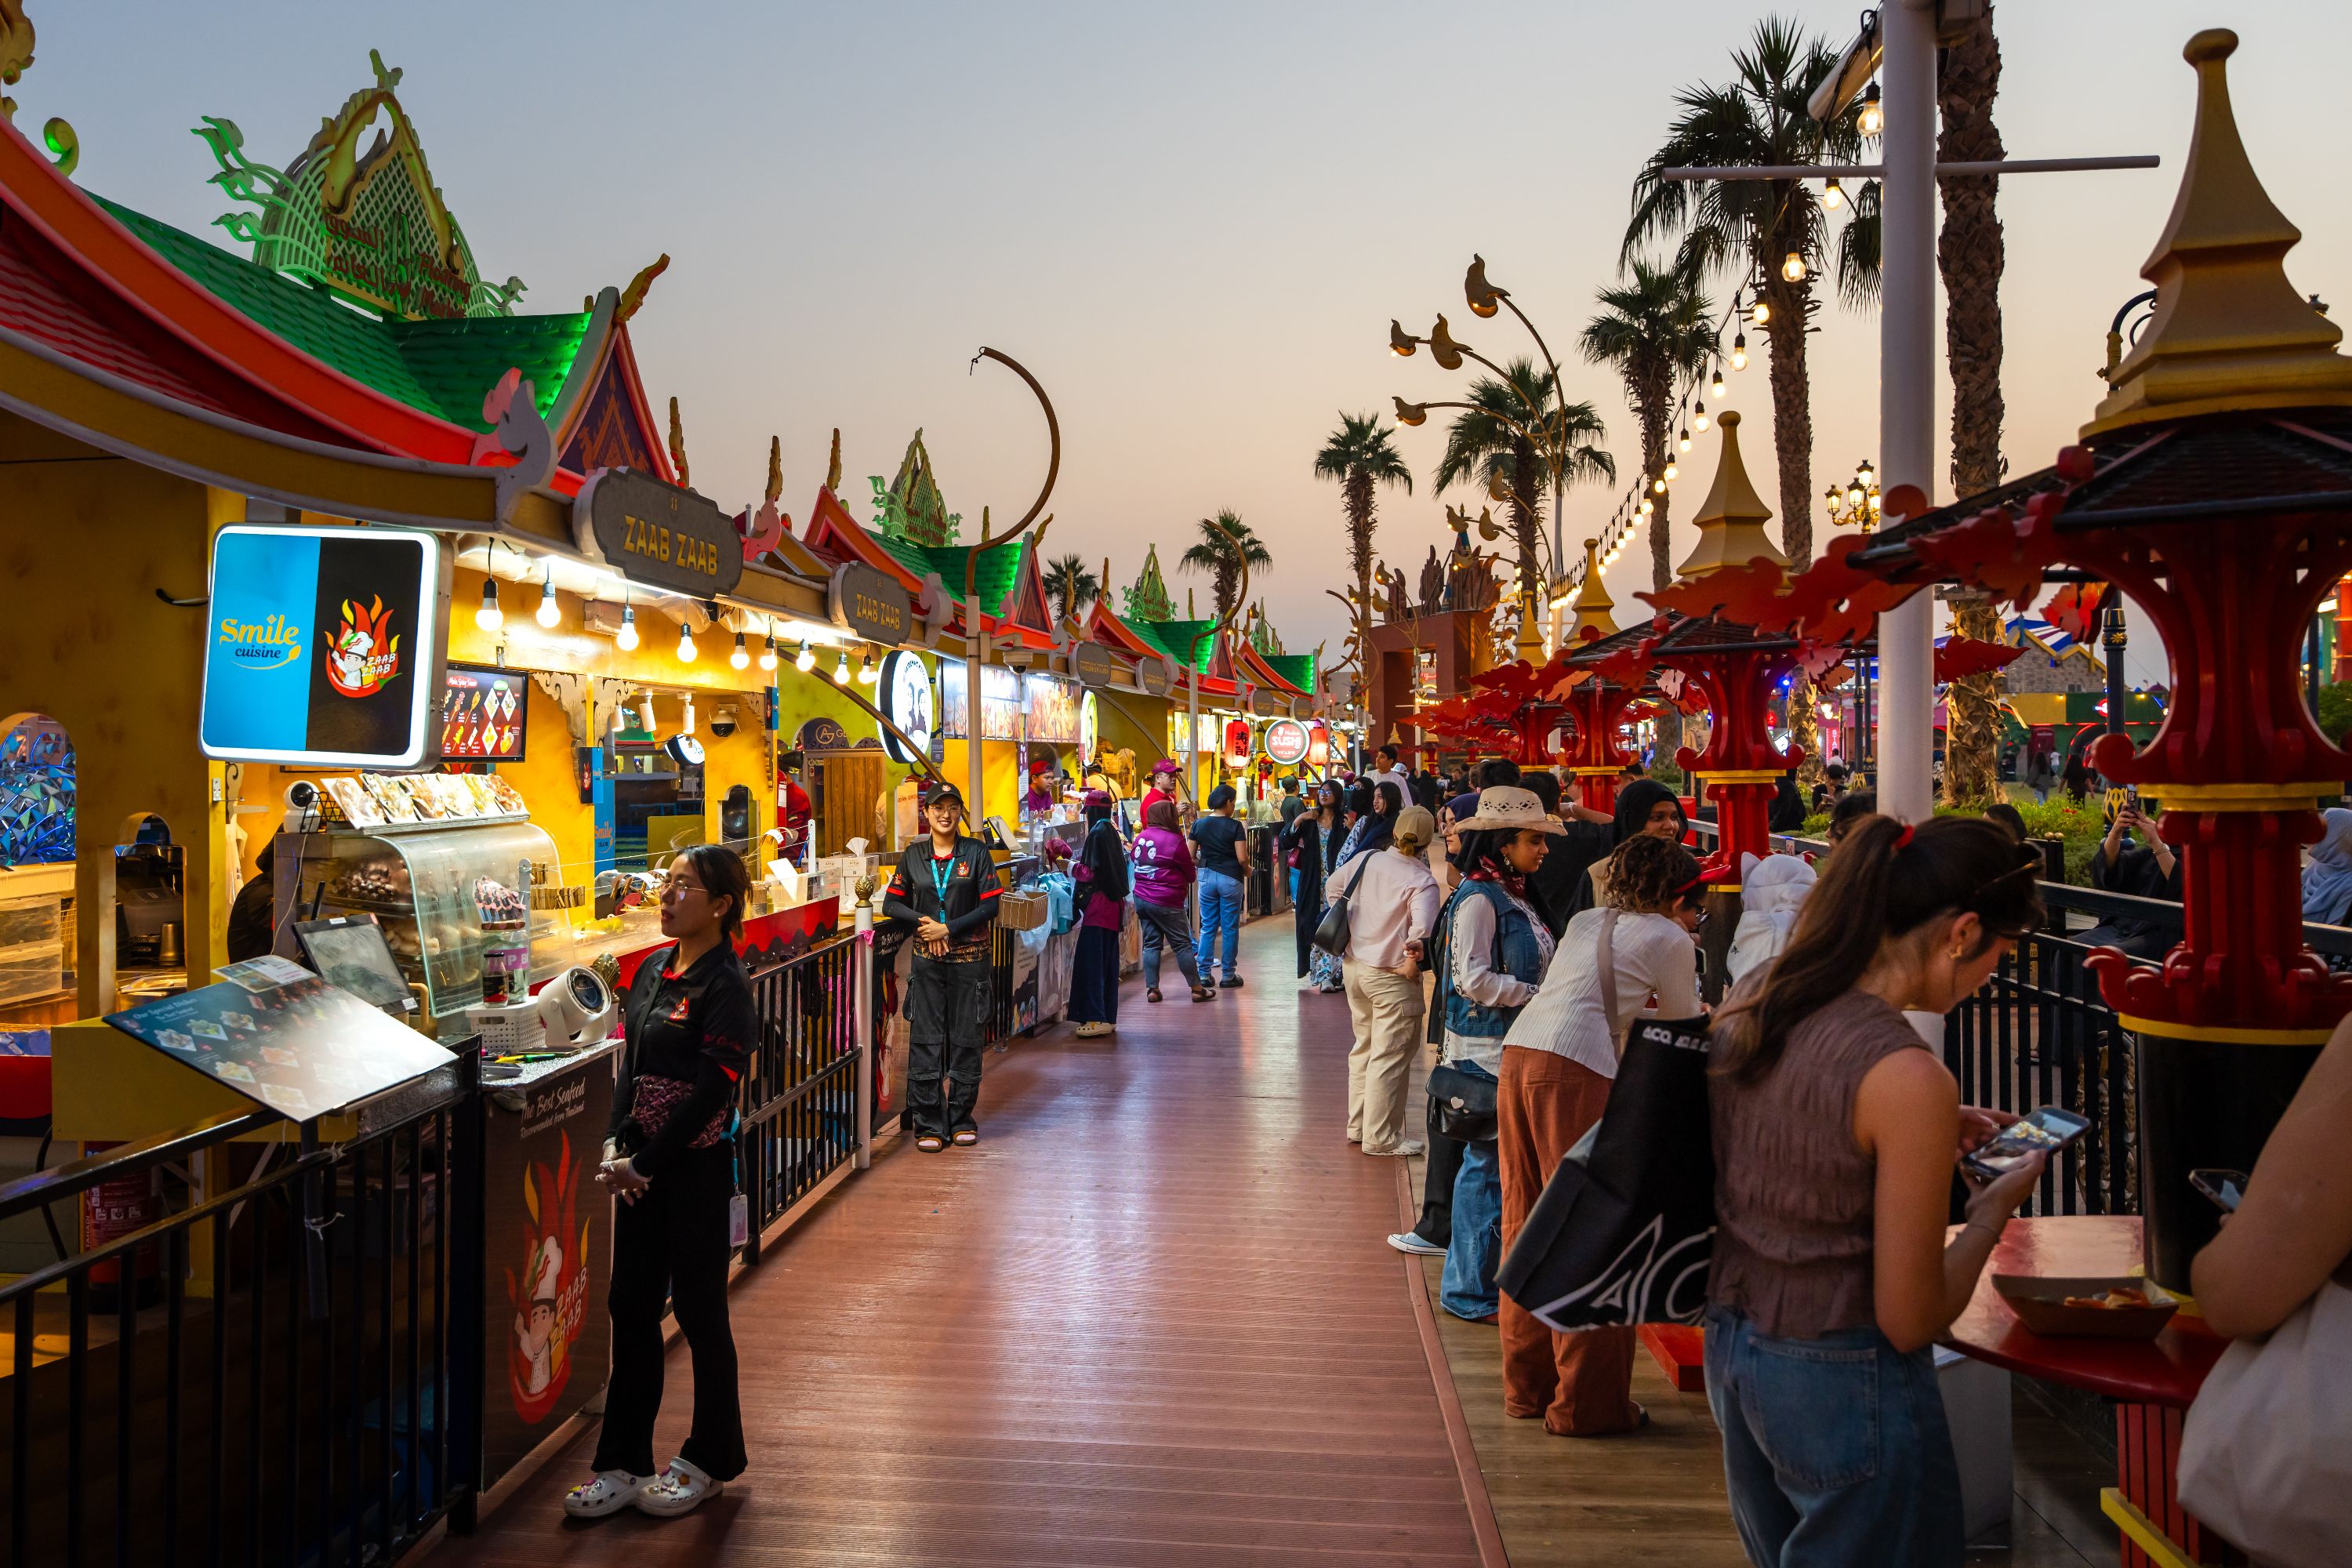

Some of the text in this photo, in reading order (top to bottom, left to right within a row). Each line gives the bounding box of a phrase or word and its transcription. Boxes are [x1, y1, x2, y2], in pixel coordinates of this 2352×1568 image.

[624, 514, 718, 576] ZAAB ZAAB
[856, 593, 901, 630] ZAAB ZAAB
[220, 614, 299, 646] Smile
[235, 644, 281, 659] cuisine
[367, 653, 396, 666] ZAAB
[361, 664, 390, 677] ZAAB
[521, 1076, 586, 1124] The Best Seafood
[565, 1100, 585, 1117] Thailand
[556, 1266, 587, 1321] ZAAB
[550, 1298, 582, 1356] ZAAB
